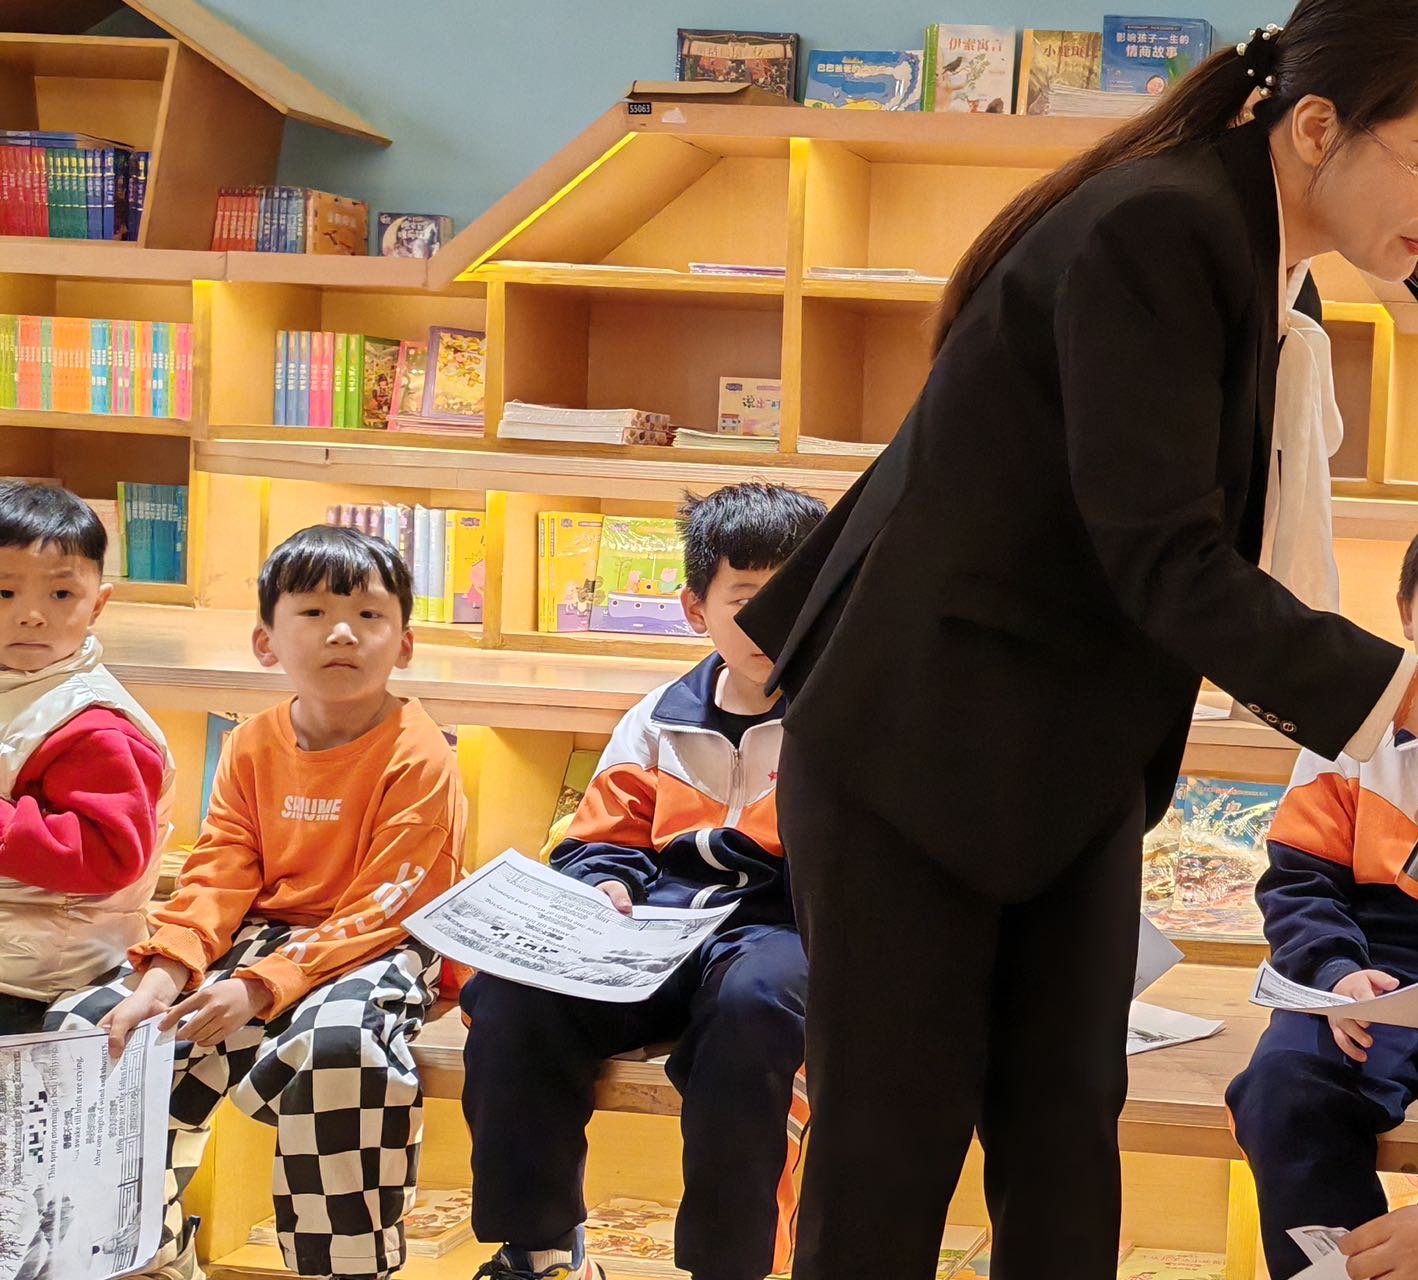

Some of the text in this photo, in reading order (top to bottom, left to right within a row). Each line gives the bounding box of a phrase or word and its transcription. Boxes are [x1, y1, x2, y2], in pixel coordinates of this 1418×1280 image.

[1116, 32, 1189, 45] 影响孩子一生的
[1126, 44, 1177, 59] 情商故事
[74, 1095, 82, 1114] birds
[98, 1088, 106, 1106] wind
[97, 1106, 104, 1114] of
[50, 1107, 60, 1139] morning
[96, 1114, 104, 1134] night
[48, 1140, 58, 1162] spring
[48, 1164, 56, 1180] This
